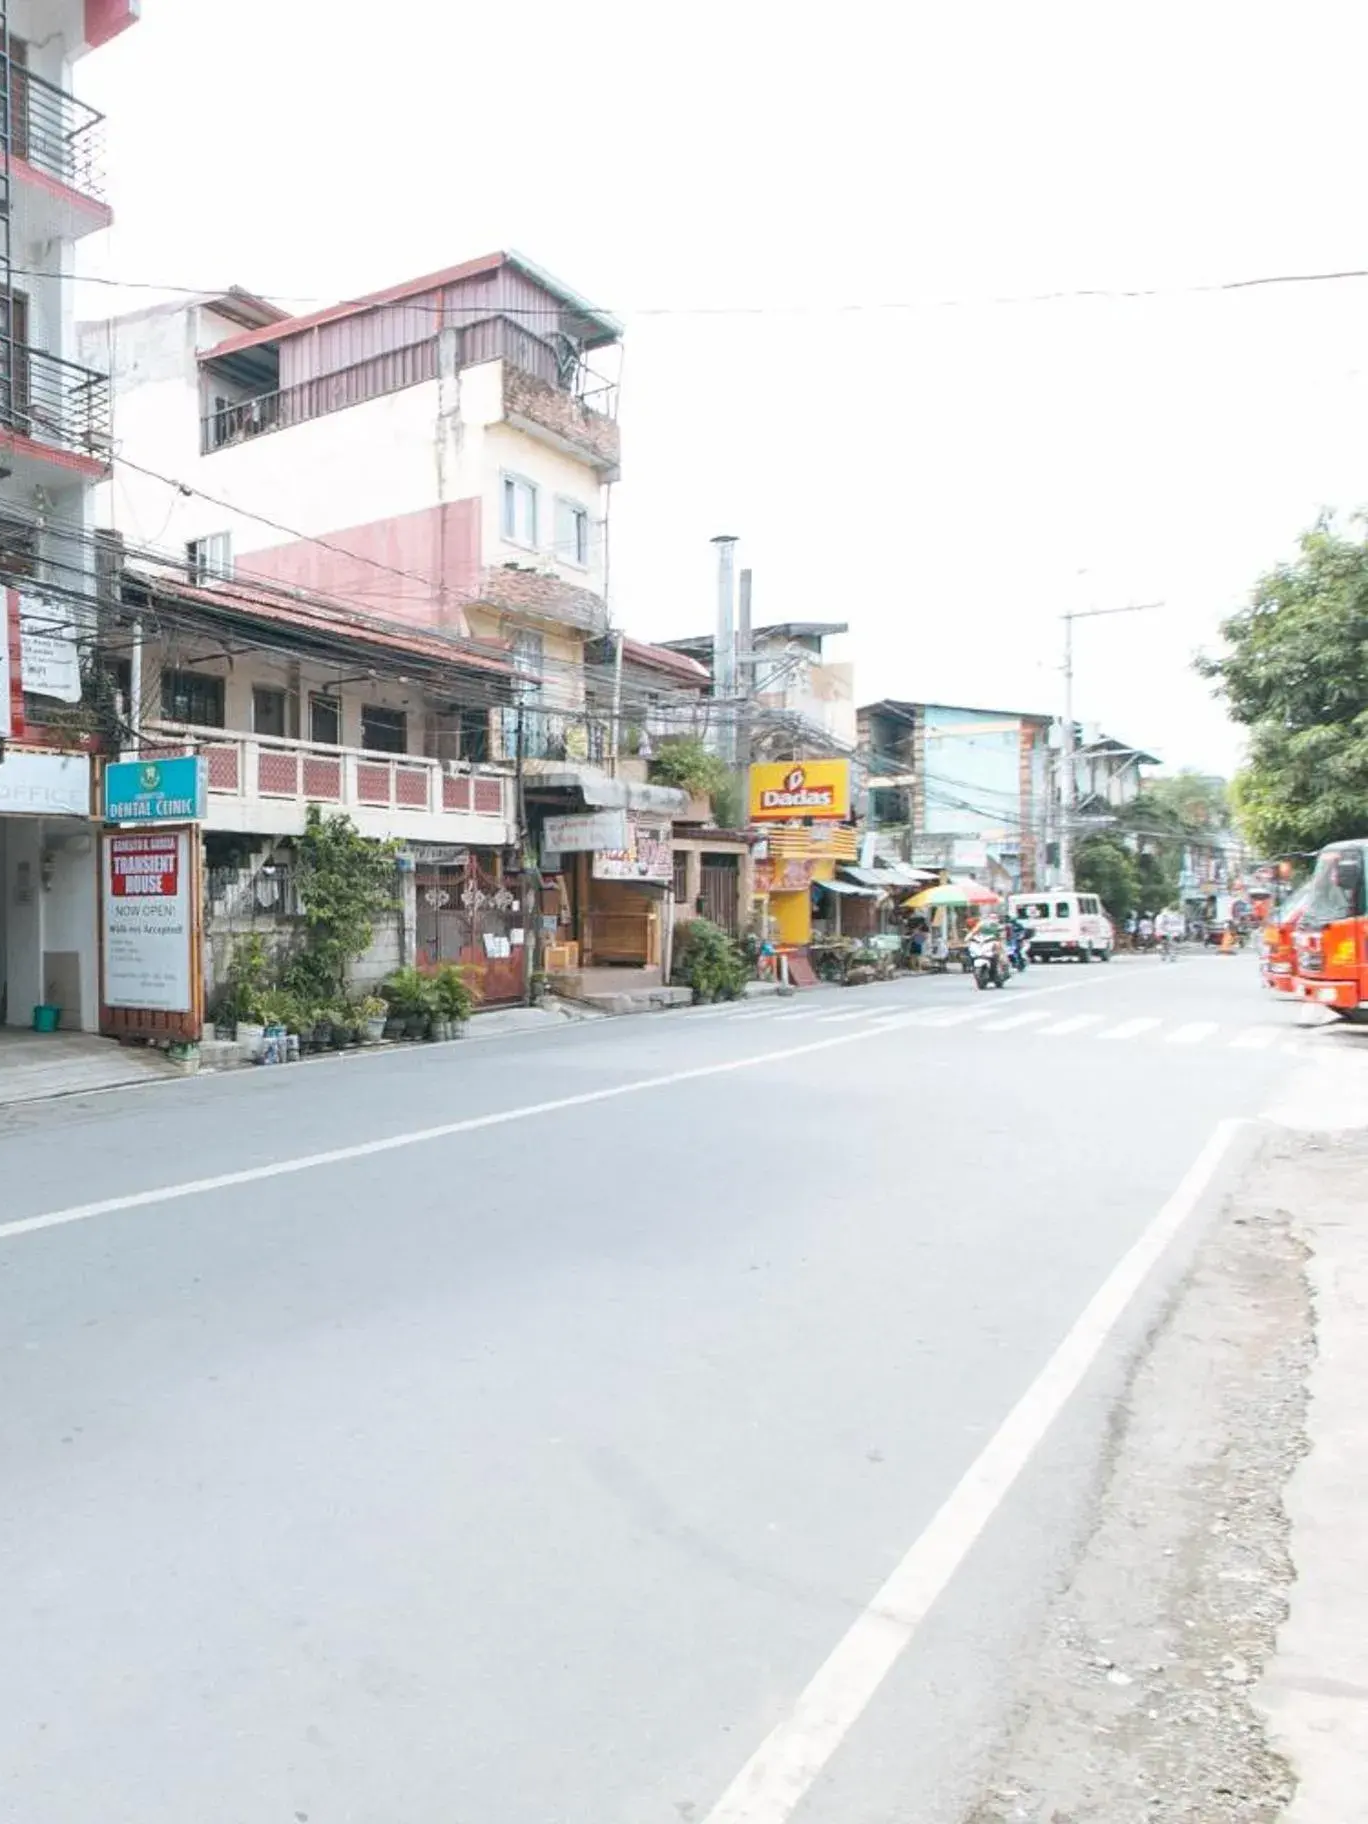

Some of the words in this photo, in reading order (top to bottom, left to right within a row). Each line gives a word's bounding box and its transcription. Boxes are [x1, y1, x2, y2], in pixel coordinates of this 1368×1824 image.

[109, 802, 153, 818] DENTAL
[157, 798, 193, 816] CLINIC
[764, 789, 832, 807] Dadas
[113, 854, 176, 874] TRANSIENT
[126, 873, 163, 894] HOUSE
[115, 905, 140, 917] NOW
